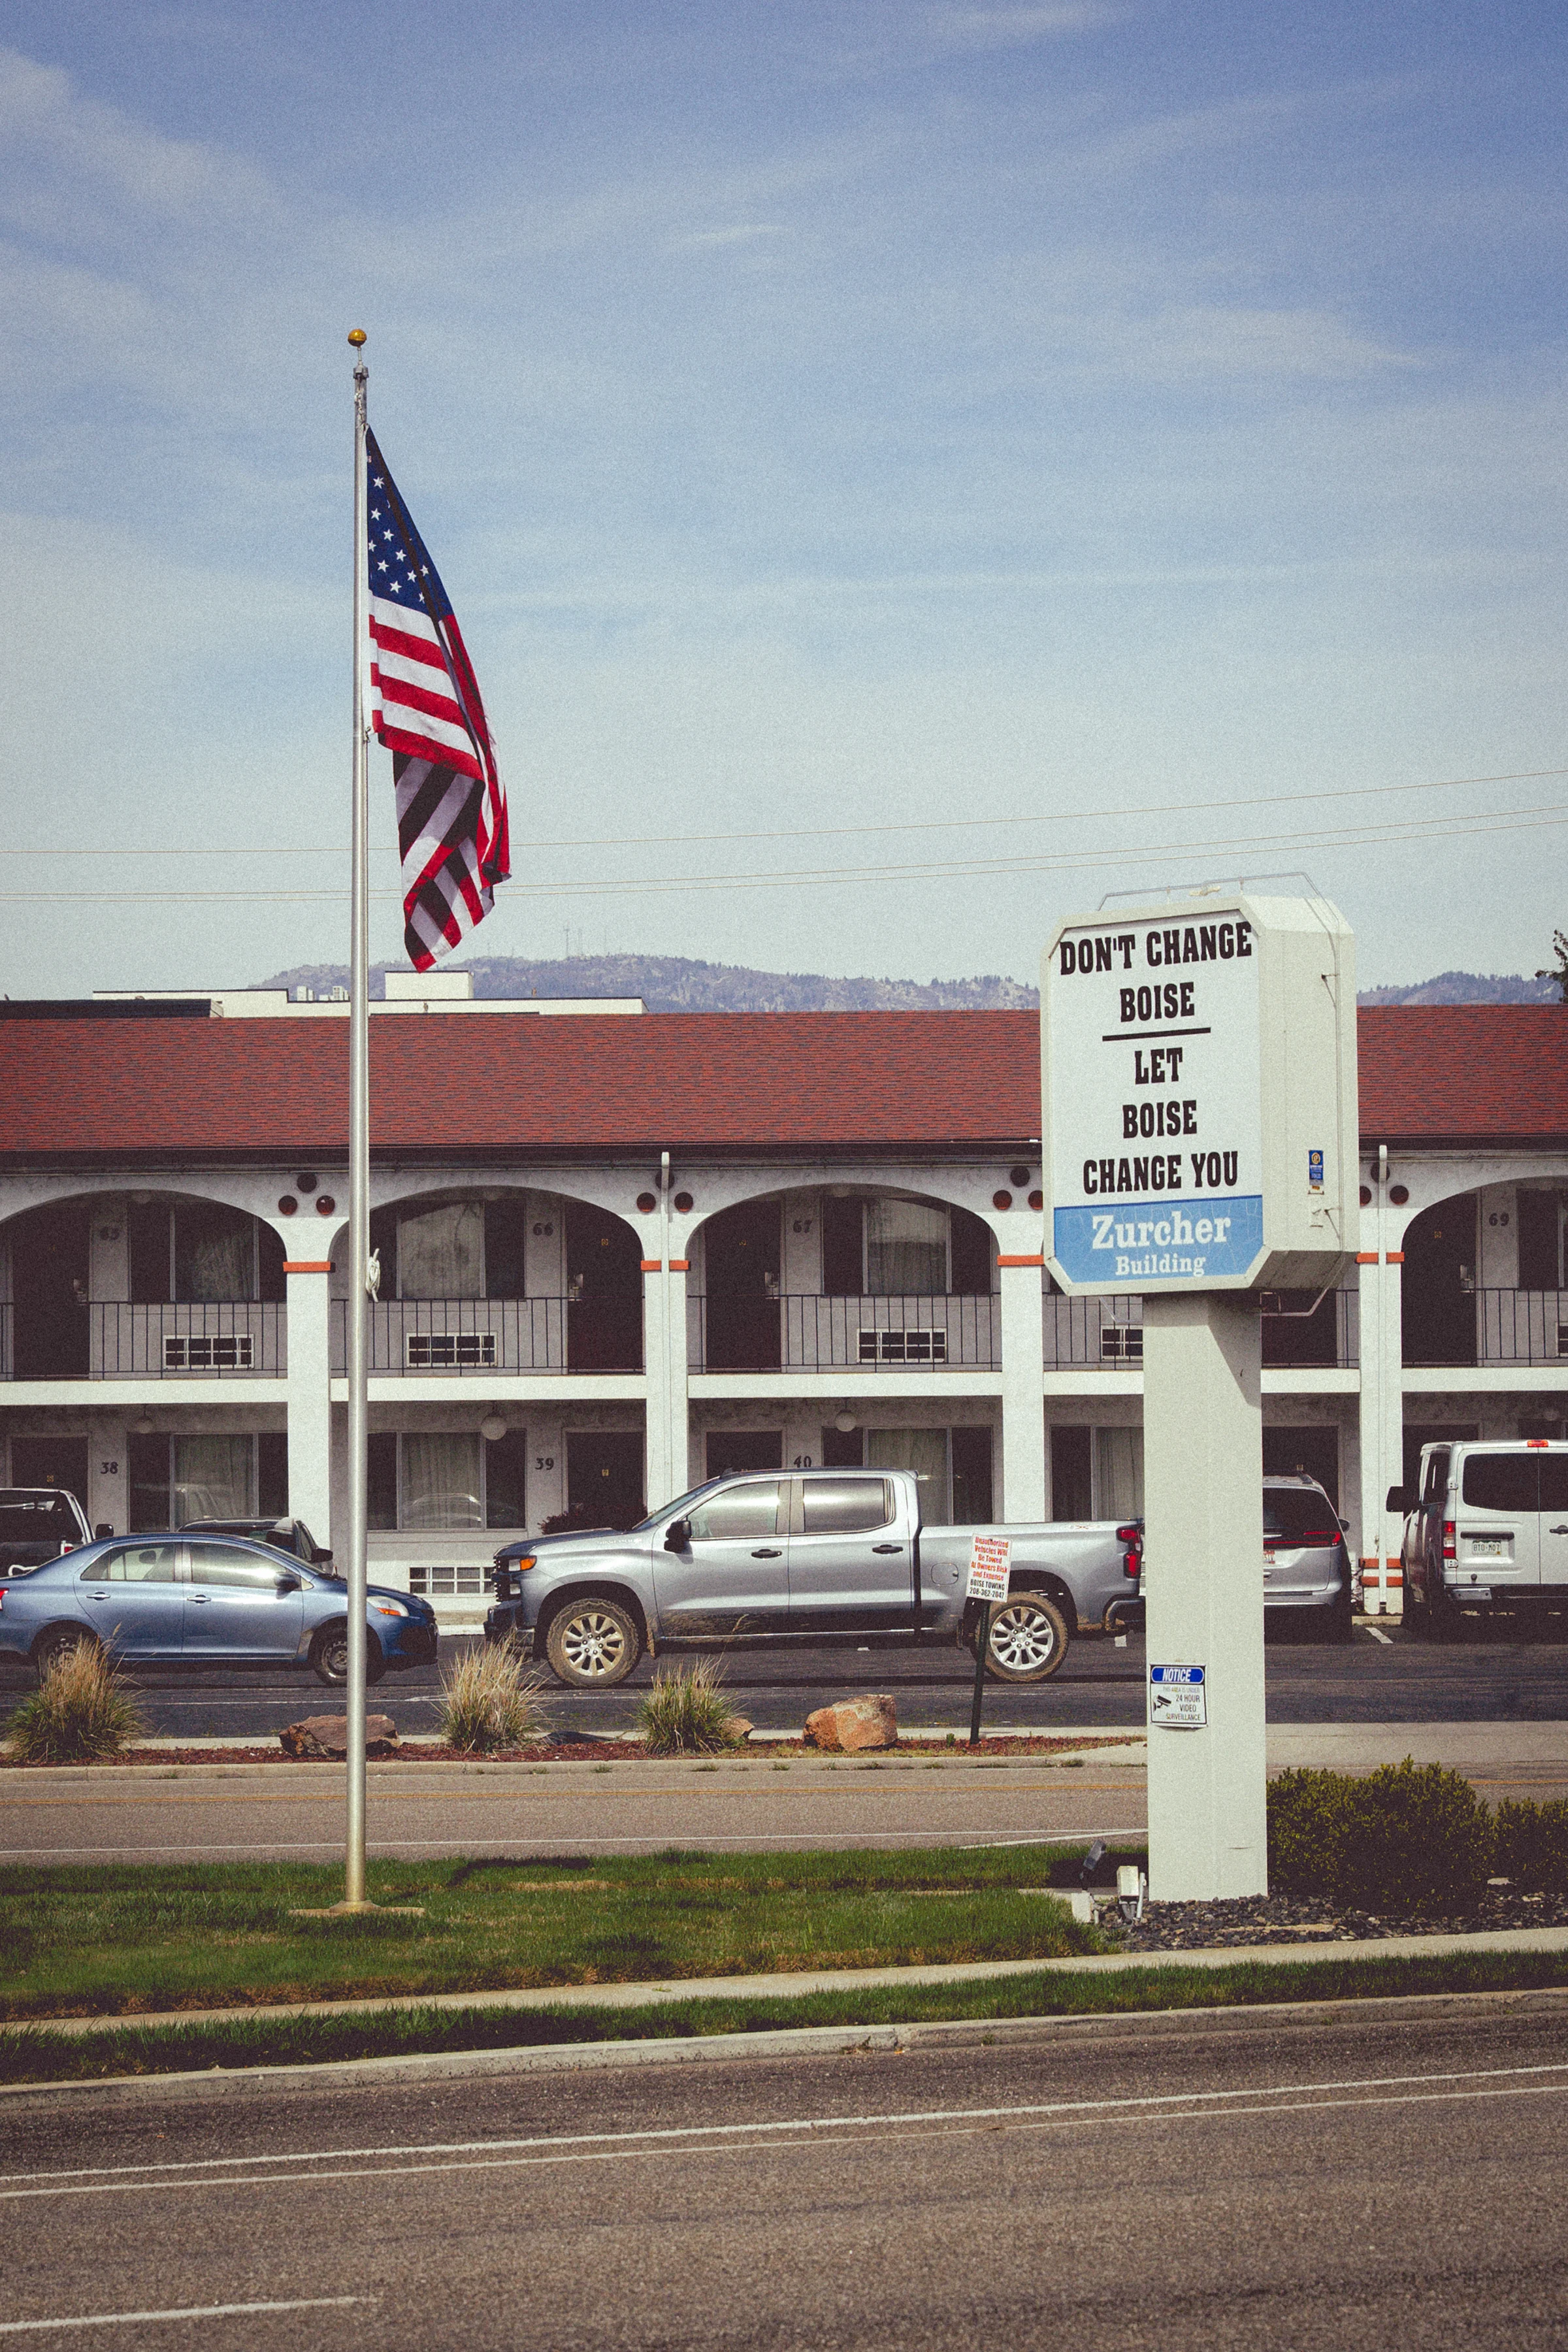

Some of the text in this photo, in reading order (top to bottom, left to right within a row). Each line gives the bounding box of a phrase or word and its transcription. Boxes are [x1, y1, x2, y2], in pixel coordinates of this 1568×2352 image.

[1058, 921, 1252, 975] DON'T CHANGE
[1120, 981, 1195, 1022] BOISE
[1135, 1047, 1183, 1085] LET
[1122, 1100, 1197, 1139] BOISE
[1083, 1151, 1238, 1194] CHANGE YOU
[793, 1219, 812, 1233] 67
[1489, 1213, 1509, 1226] 69
[533, 1222, 553, 1236] 66
[1092, 1211, 1232, 1250] Zurcher
[1115, 1252, 1206, 1277] Building
[100, 1462, 118, 1474] 38
[535, 1458, 554, 1470] 39
[793, 1455, 812, 1467] 40
[975, 1545, 996, 1554] Vehicles
[986, 1555, 1002, 1564] Towed
[977, 1562, 996, 1571] Owners
[997, 1564, 1007, 1573] Risk
[983, 1572, 1004, 1581] Expense
[970, 1578, 1005, 1590] BOISE TOWING
[1162, 1668, 1192, 1682] NOTICE
